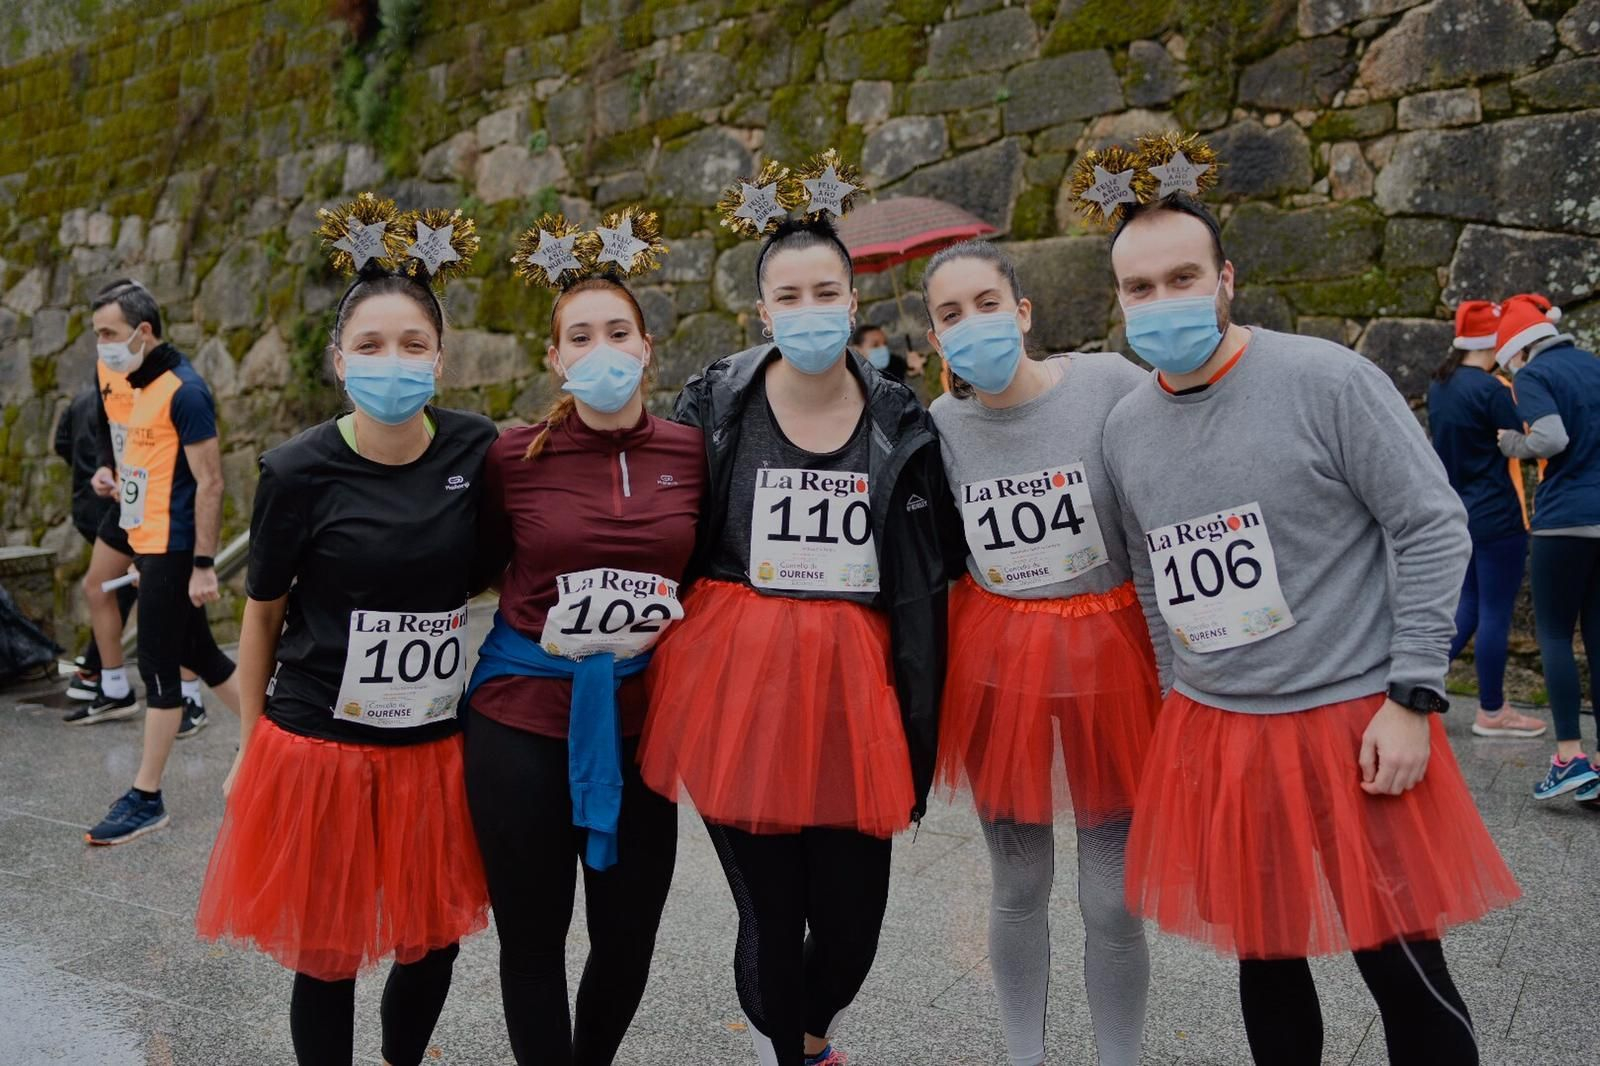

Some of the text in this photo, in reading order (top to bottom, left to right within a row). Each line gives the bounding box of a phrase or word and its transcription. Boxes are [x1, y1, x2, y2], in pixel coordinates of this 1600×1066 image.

[760, 470, 868, 497] La Regió
[964, 484, 992, 504] La
[767, 496, 872, 546] 110
[978, 492, 1085, 551] 104
[1146, 532, 1172, 553] La
[780, 570, 824, 579] OURENSE
[1006, 566, 1050, 582] OURENSE
[1164, 538, 1262, 606] 106
[560, 575, 593, 595] La
[356, 612, 391, 633] La
[560, 595, 672, 635] 102
[1189, 627, 1228, 642] OURENSE
[359, 636, 460, 684] 100
[367, 708, 412, 718] OURENSE
